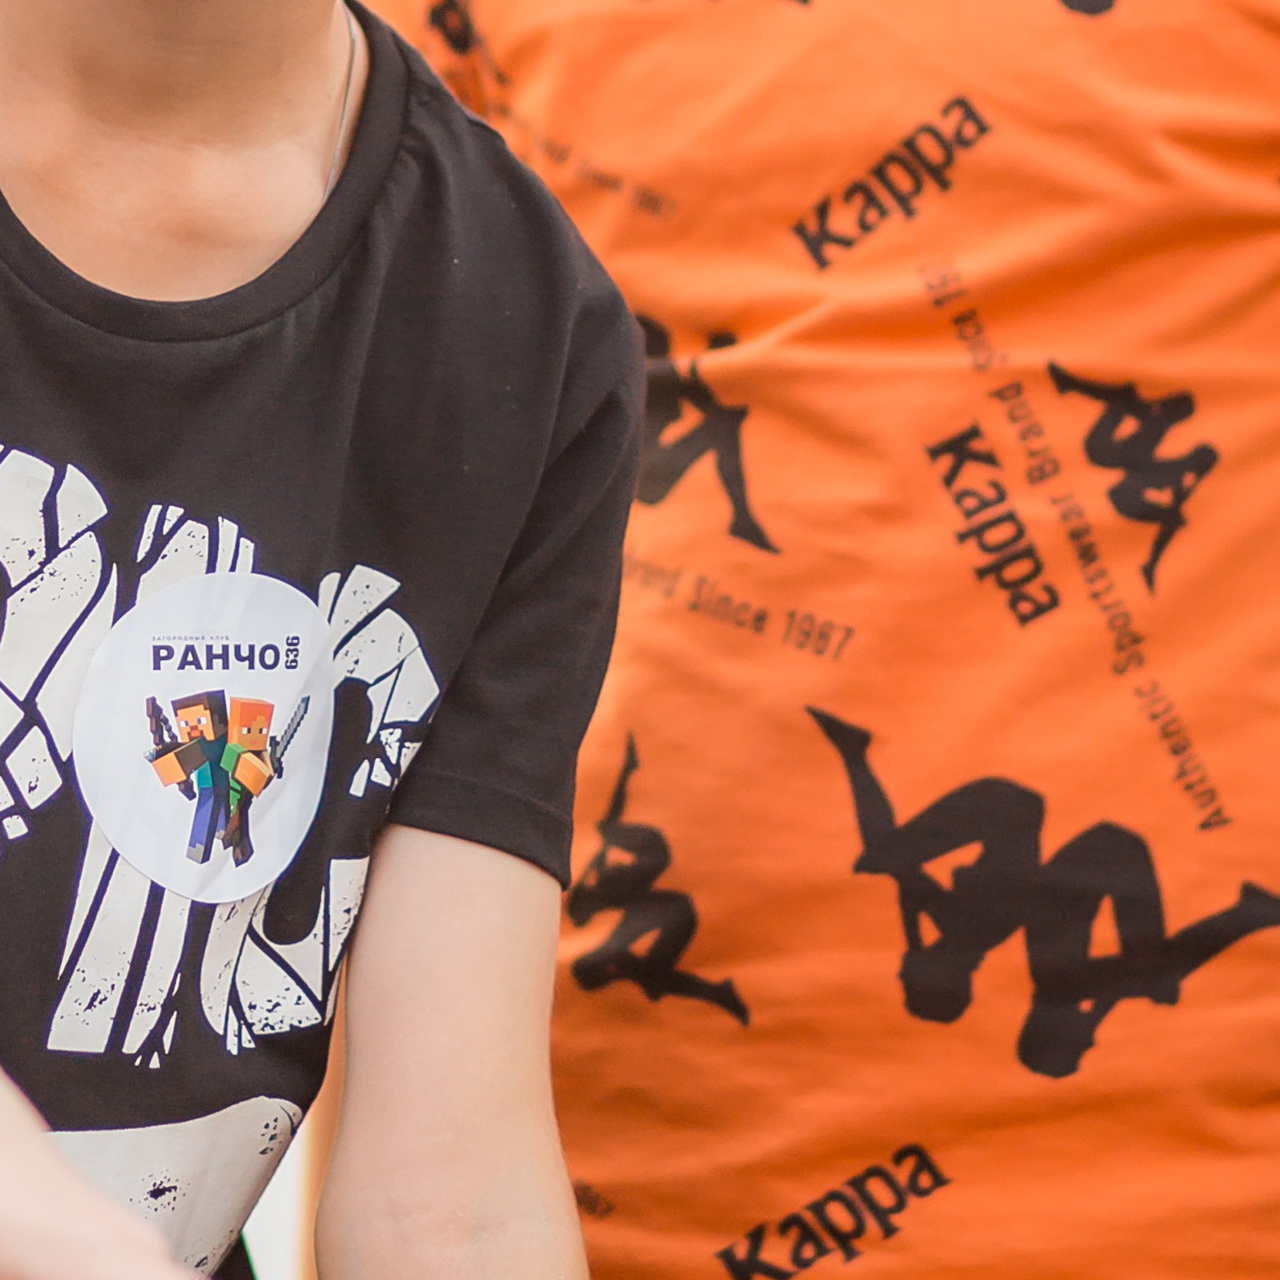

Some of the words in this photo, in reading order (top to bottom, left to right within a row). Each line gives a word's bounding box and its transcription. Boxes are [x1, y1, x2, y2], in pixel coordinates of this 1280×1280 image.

[792, 96, 991, 270] Kappa
[987, 382, 1062, 487] Brand
[925, 422, 1060, 627] Kappa
[1049, 492, 1146, 675] Sportswear
[152, 644, 281, 671] РАНЧО
[284, 635, 301, 670] 636
[1132, 679, 1233, 832] Authentic
